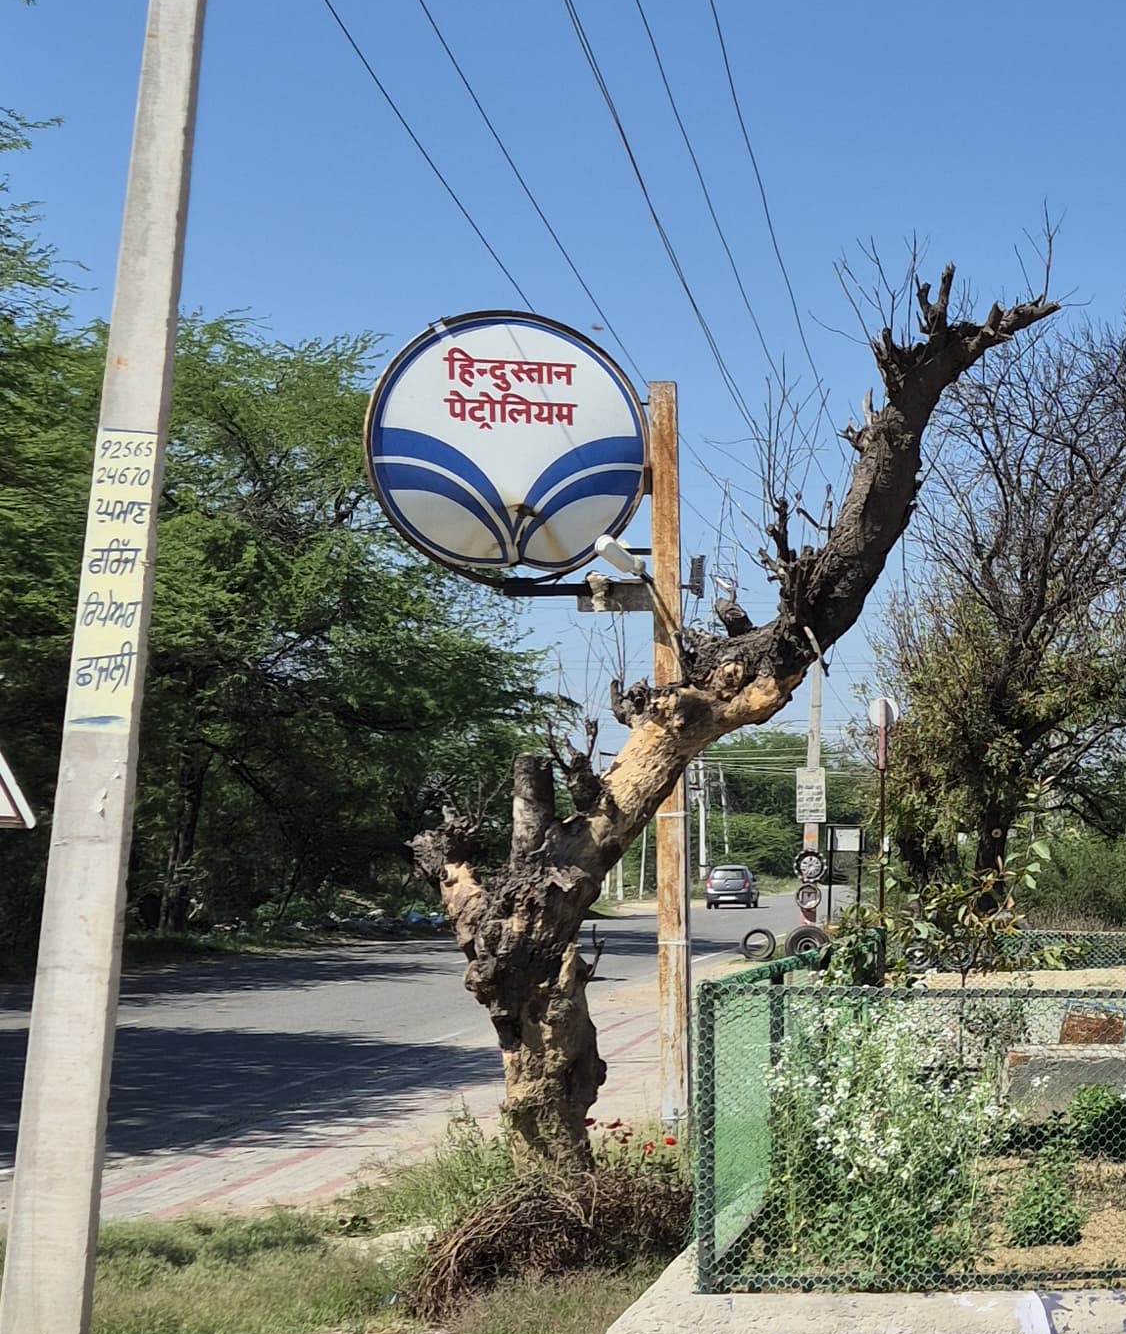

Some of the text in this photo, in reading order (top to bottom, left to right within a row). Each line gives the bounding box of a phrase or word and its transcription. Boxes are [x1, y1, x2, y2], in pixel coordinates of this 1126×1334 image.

[443, 347, 577, 391] हिन्दुस्तान
[443, 390, 578, 429] पेट्रोलियम
[99, 439, 154, 459] 92565
[96, 466, 151, 486] 24670
